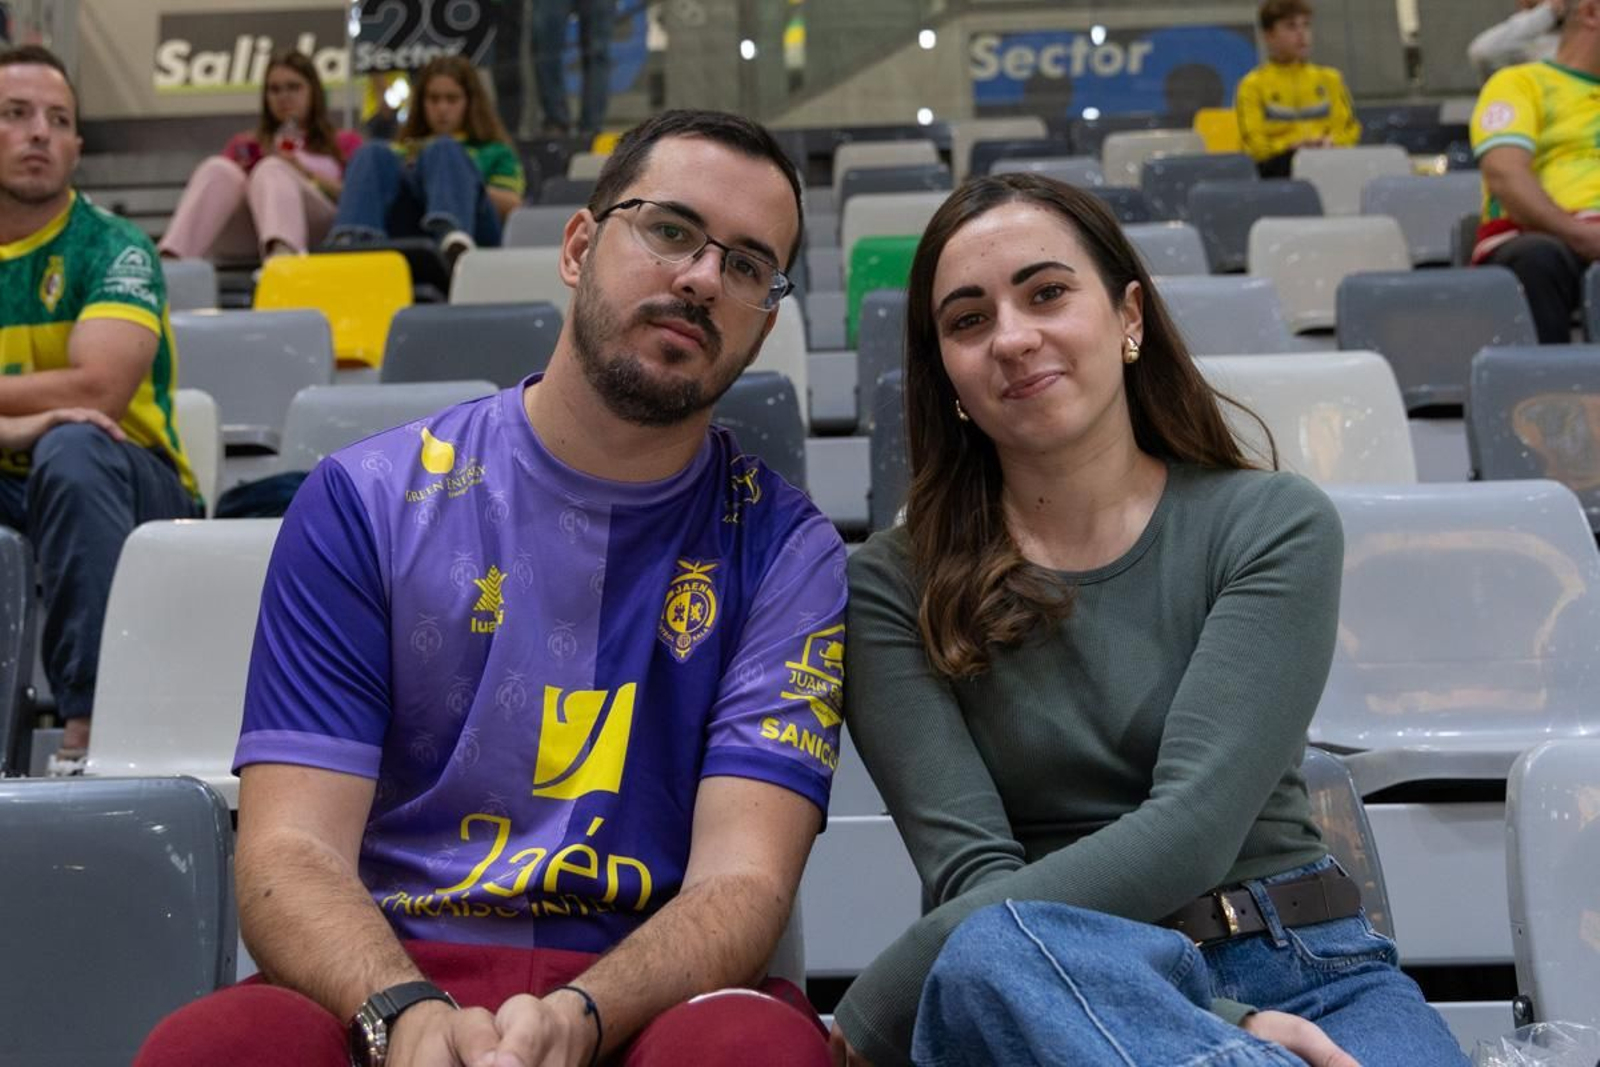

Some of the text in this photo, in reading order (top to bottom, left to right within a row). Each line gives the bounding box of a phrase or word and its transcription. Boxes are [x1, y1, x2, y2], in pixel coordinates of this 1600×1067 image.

[155, 35, 348, 86] Salia
[969, 34, 1153, 80] Sector
[788, 670, 828, 692] JUAN
